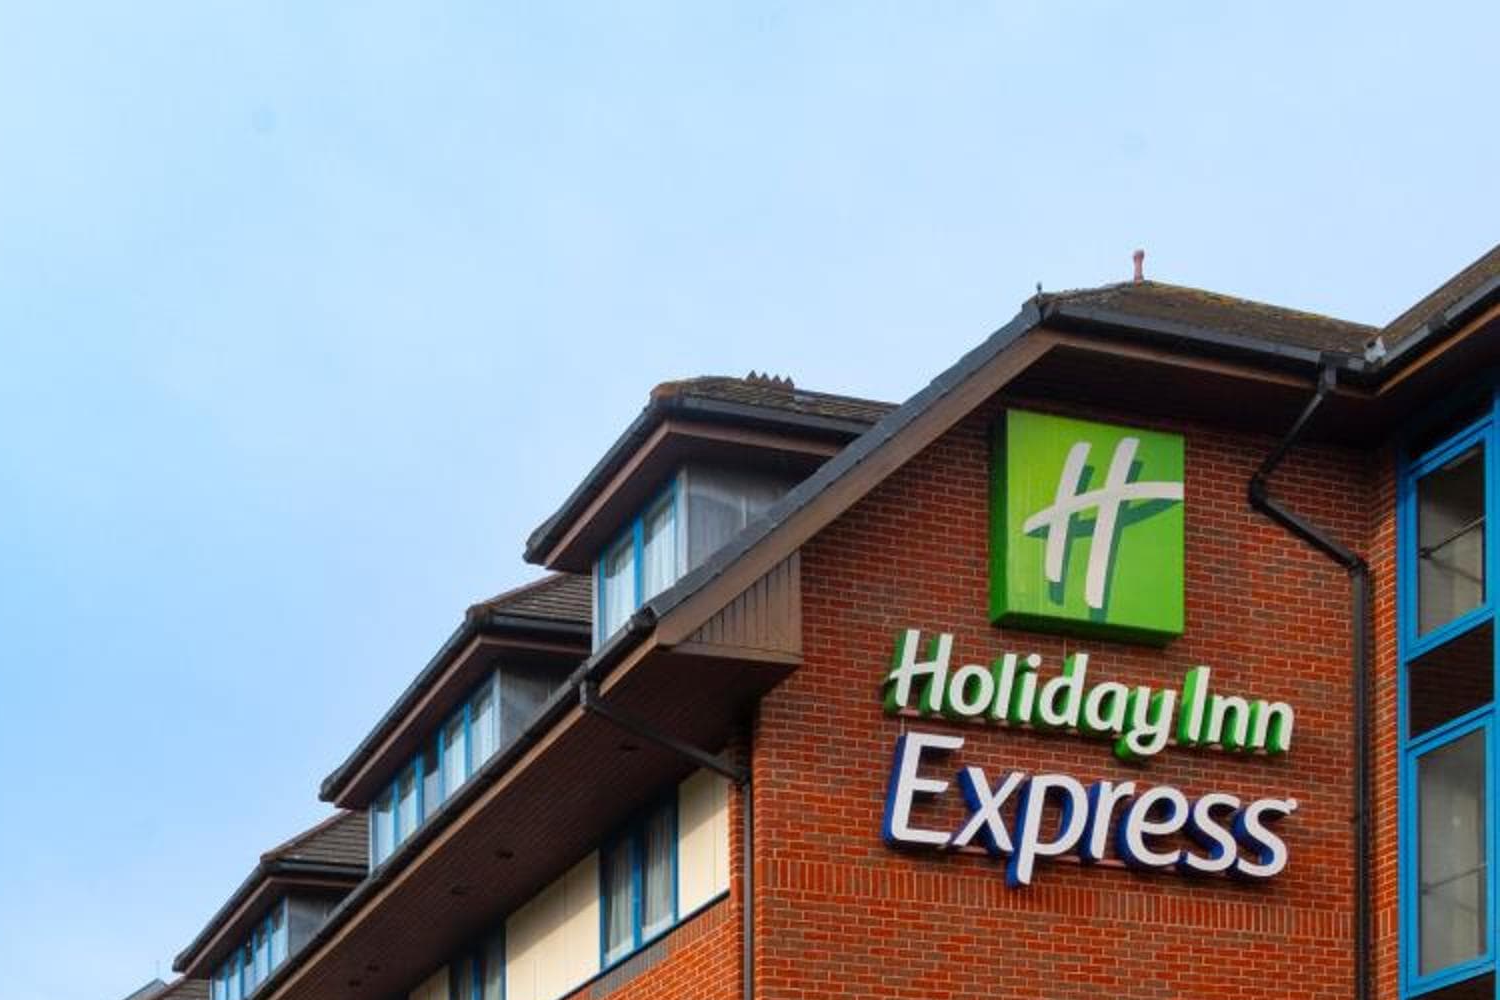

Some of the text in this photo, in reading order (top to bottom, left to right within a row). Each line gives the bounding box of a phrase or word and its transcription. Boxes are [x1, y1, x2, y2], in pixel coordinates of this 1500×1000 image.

[885, 629, 1296, 757] Holiday Inn
[884, 732, 1298, 886] Express
